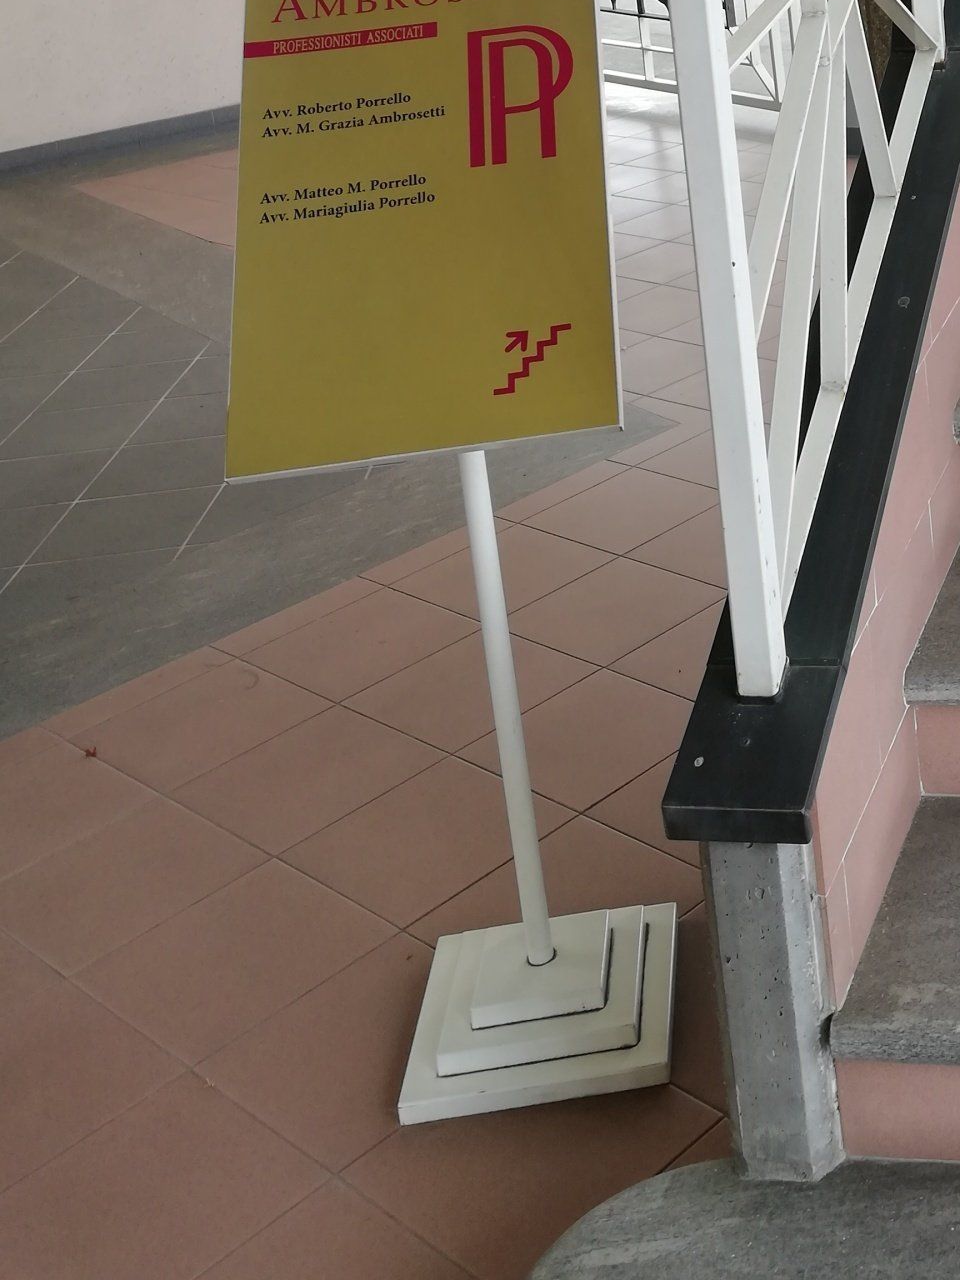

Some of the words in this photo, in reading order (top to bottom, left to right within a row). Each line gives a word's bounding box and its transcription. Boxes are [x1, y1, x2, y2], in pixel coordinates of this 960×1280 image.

[273, 34, 361, 54] PROFESSIONISTI
[367, 25, 424, 45] ASSOCIATI
[262, 106, 293, 120] Avv.
[297, 99, 352, 116] Roberto
[356, 92, 411, 110] Porrello
[262, 125, 292, 138] Avv.
[296, 121, 314, 134] M.
[318, 116, 364, 132] Grazia
[368, 105, 445, 126] Ambrosetti
[260, 191, 290, 205] Avv.
[294, 184, 344, 201] Matteo
[347, 181, 366, 194] M.
[370, 173, 426, 192] Porrello
[259, 210, 289, 224] Avv.
[293, 200, 375, 221] Mariagiulia
[379, 191, 435, 210] Porrello
